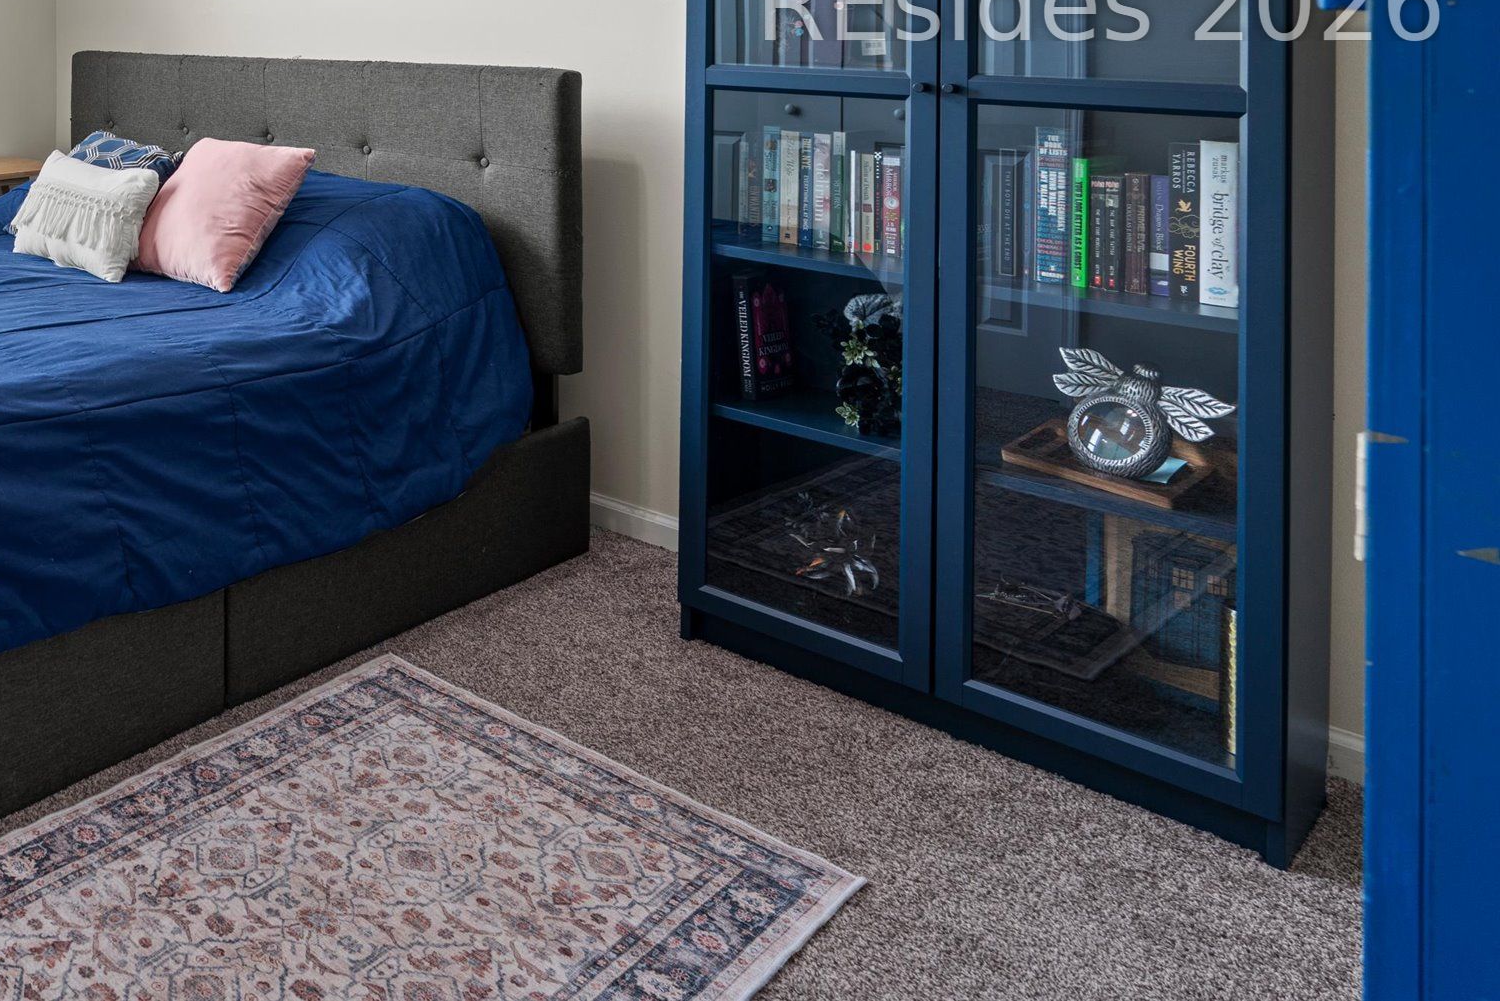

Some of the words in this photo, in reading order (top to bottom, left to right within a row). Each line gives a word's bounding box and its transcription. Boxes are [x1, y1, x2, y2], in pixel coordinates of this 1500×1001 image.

[802, 138, 811, 154] BILL
[1049, 148, 1068, 156] LISTS
[802, 156, 811, 170] NYE
[1172, 154, 1182, 189] YARROS
[1186, 151, 1196, 194] REBECCA
[1212, 157, 1220, 180] zusak
[1220, 154, 1229, 184] markus
[814, 163, 828, 222] delirium
[1004, 223, 1010, 231] AT
[1137, 205, 1145, 232] PRIME
[1210, 192, 1230, 234] bridge
[1156, 232, 1164, 252] Blood
[1212, 238, 1225, 250] of
[1173, 250, 1184, 274] WING
[1184, 244, 1196, 282] FOURTH
[1208, 250, 1229, 280] clay
[738, 300, 748, 333] VEILED
[740, 333, 751, 377] KINGDOM
